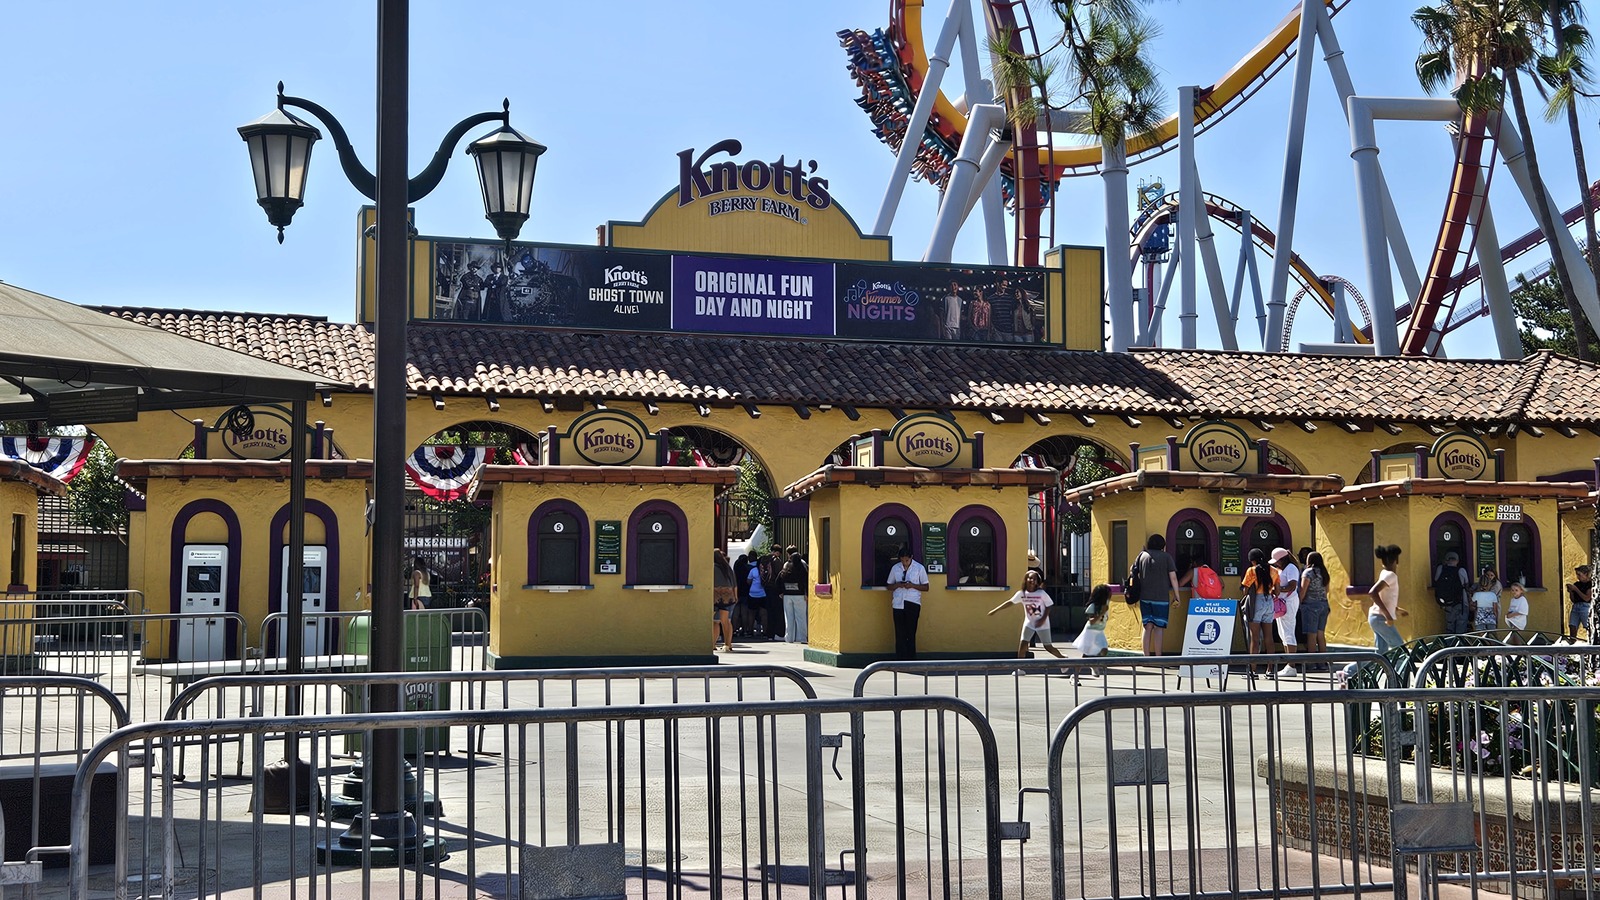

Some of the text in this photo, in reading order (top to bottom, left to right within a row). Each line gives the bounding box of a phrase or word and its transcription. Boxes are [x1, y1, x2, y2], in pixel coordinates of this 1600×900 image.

[676, 138, 832, 211] Knott's
[709, 196, 800, 223] BERRY FARM
[604, 265, 648, 286] Knott's
[695, 270, 813, 297] ORIGINAL FUN
[588, 287, 664, 304] GHOST TOWN
[861, 290, 902, 305] Summer
[613, 304, 640, 314] ALIVE!
[695, 296, 813, 320] DAY AND NIGHT
[847, 303, 916, 321] NIGHTS
[583, 428, 635, 451] Knott's
[905, 431, 953, 454] Knott's
[1198, 439, 1241, 460] Knott's
[1443, 449, 1481, 469] Knott's
[1246, 497, 1272, 506] SOLD
[1498, 504, 1521, 513] SOLD
[1244, 506, 1272, 515] HERE
[1497, 512, 1521, 521] HERE
[888, 526, 895, 534] 7
[972, 527, 978, 535] 8
[1194, 606, 1231, 614] CASHLESS
